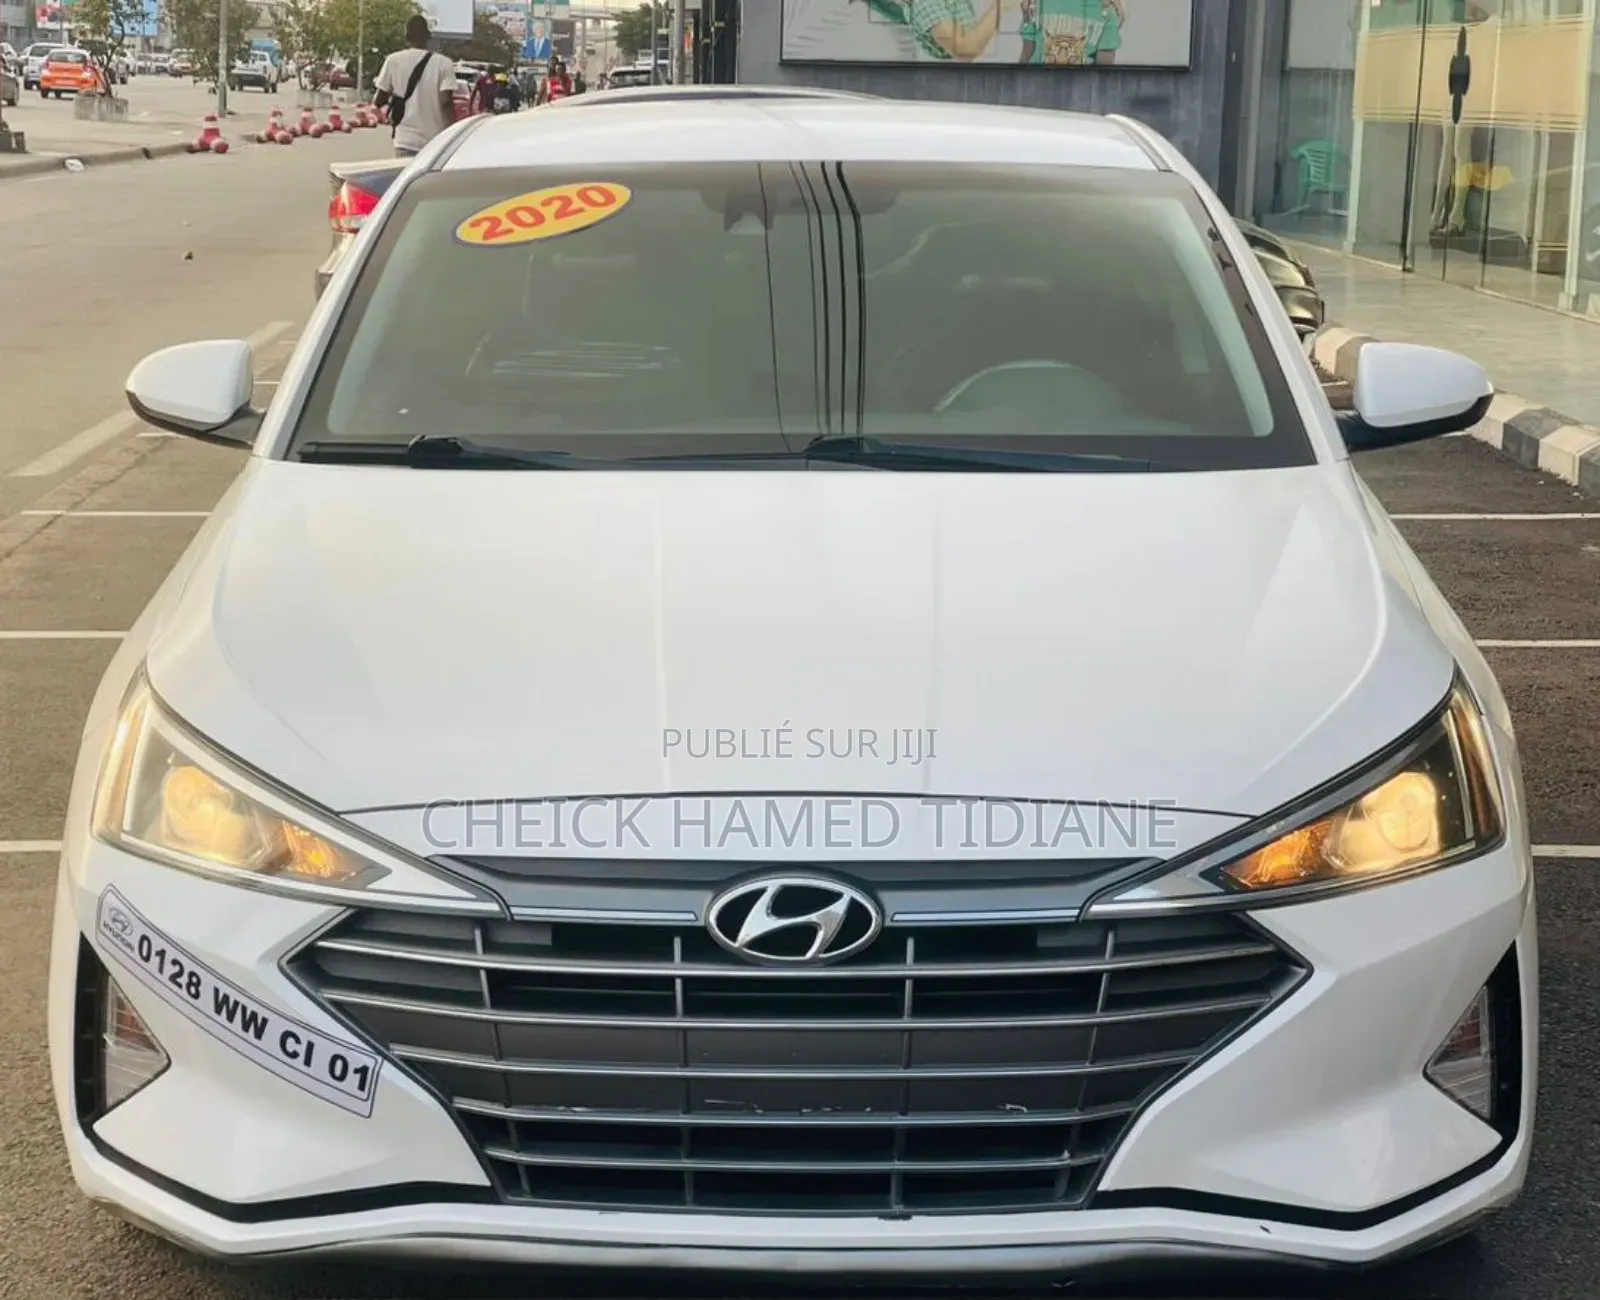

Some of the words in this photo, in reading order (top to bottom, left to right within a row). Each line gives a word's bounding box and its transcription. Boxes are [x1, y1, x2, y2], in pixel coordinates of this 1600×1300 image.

[469, 186, 617, 241] 2020
[138, 934, 202, 1000] 0128
[212, 986, 268, 1041] WW
[279, 1030, 315, 1068] CI
[328, 1053, 370, 1092] 01
